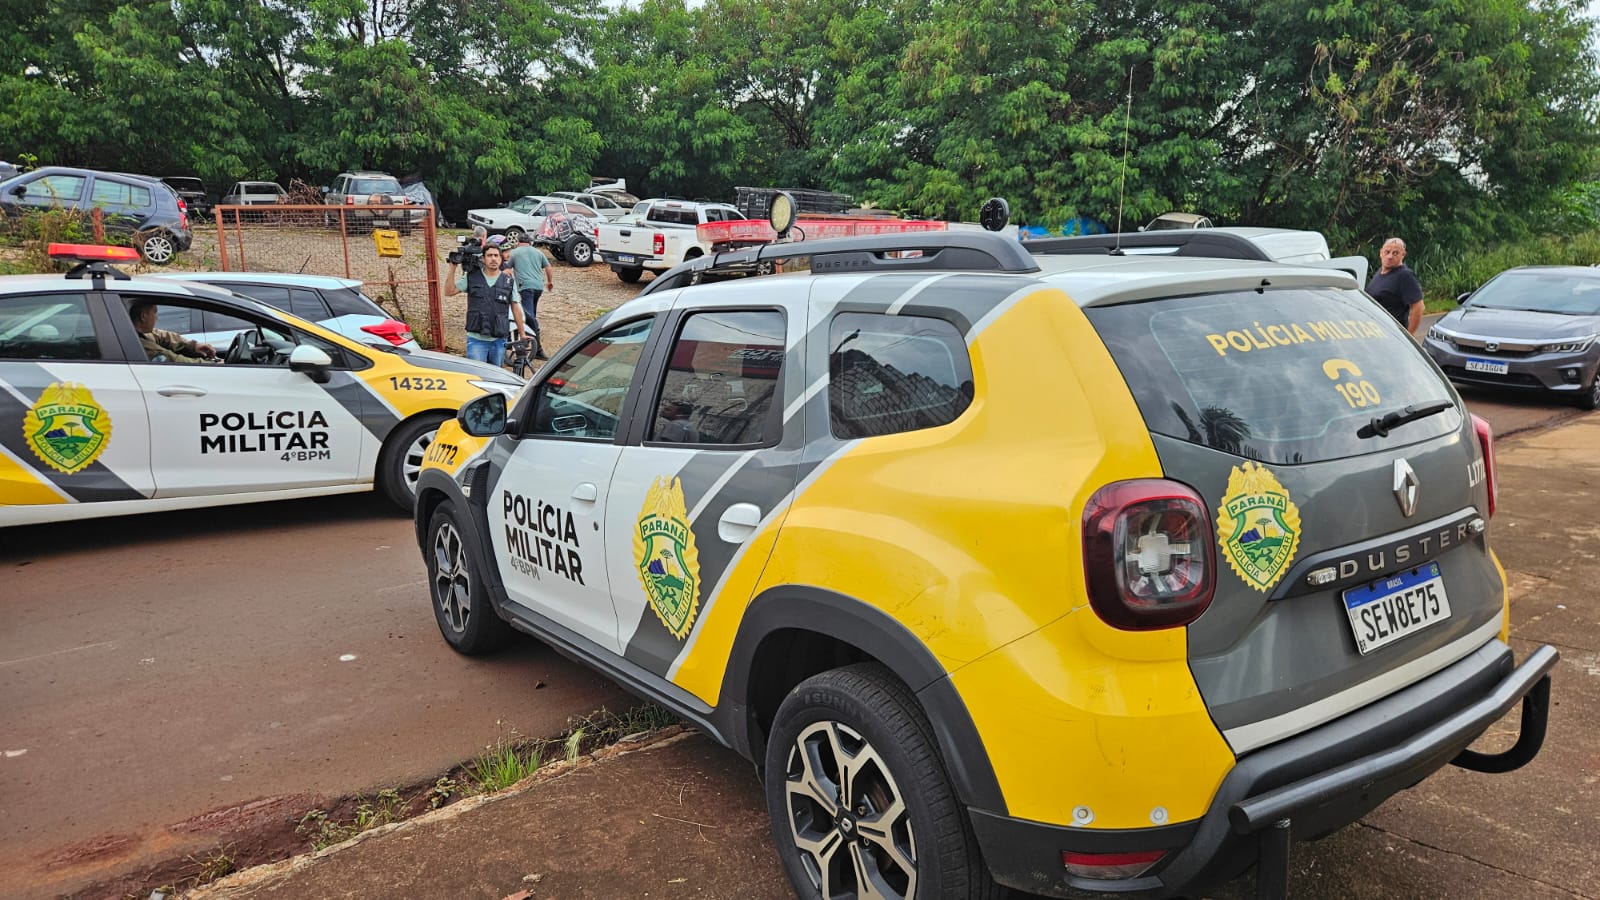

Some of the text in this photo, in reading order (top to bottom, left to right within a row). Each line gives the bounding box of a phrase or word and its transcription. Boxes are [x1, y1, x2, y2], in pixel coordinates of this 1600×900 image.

[816, 260, 869, 269] DUSTER
[1206, 320, 1388, 357] POLÍCIA MILITAR
[389, 376, 448, 391] 14322
[1334, 380, 1381, 408] 190
[199, 410, 329, 432] POLÍCIA
[200, 431, 330, 454] MILITAR
[428, 442, 458, 465] L1772
[1230, 496, 1284, 514] PARANÁ
[503, 489, 580, 548] POLÍCIA
[642, 520, 685, 543] PARANÁ
[504, 523, 586, 587] MILITAR
[1267, 535, 1292, 576] MILITAR
[1339, 523, 1467, 579] DUSTER
[1386, 577, 1404, 590] BRASIL
[674, 580, 692, 624] MILITAR
[1360, 583, 1441, 642] SEW8E75
